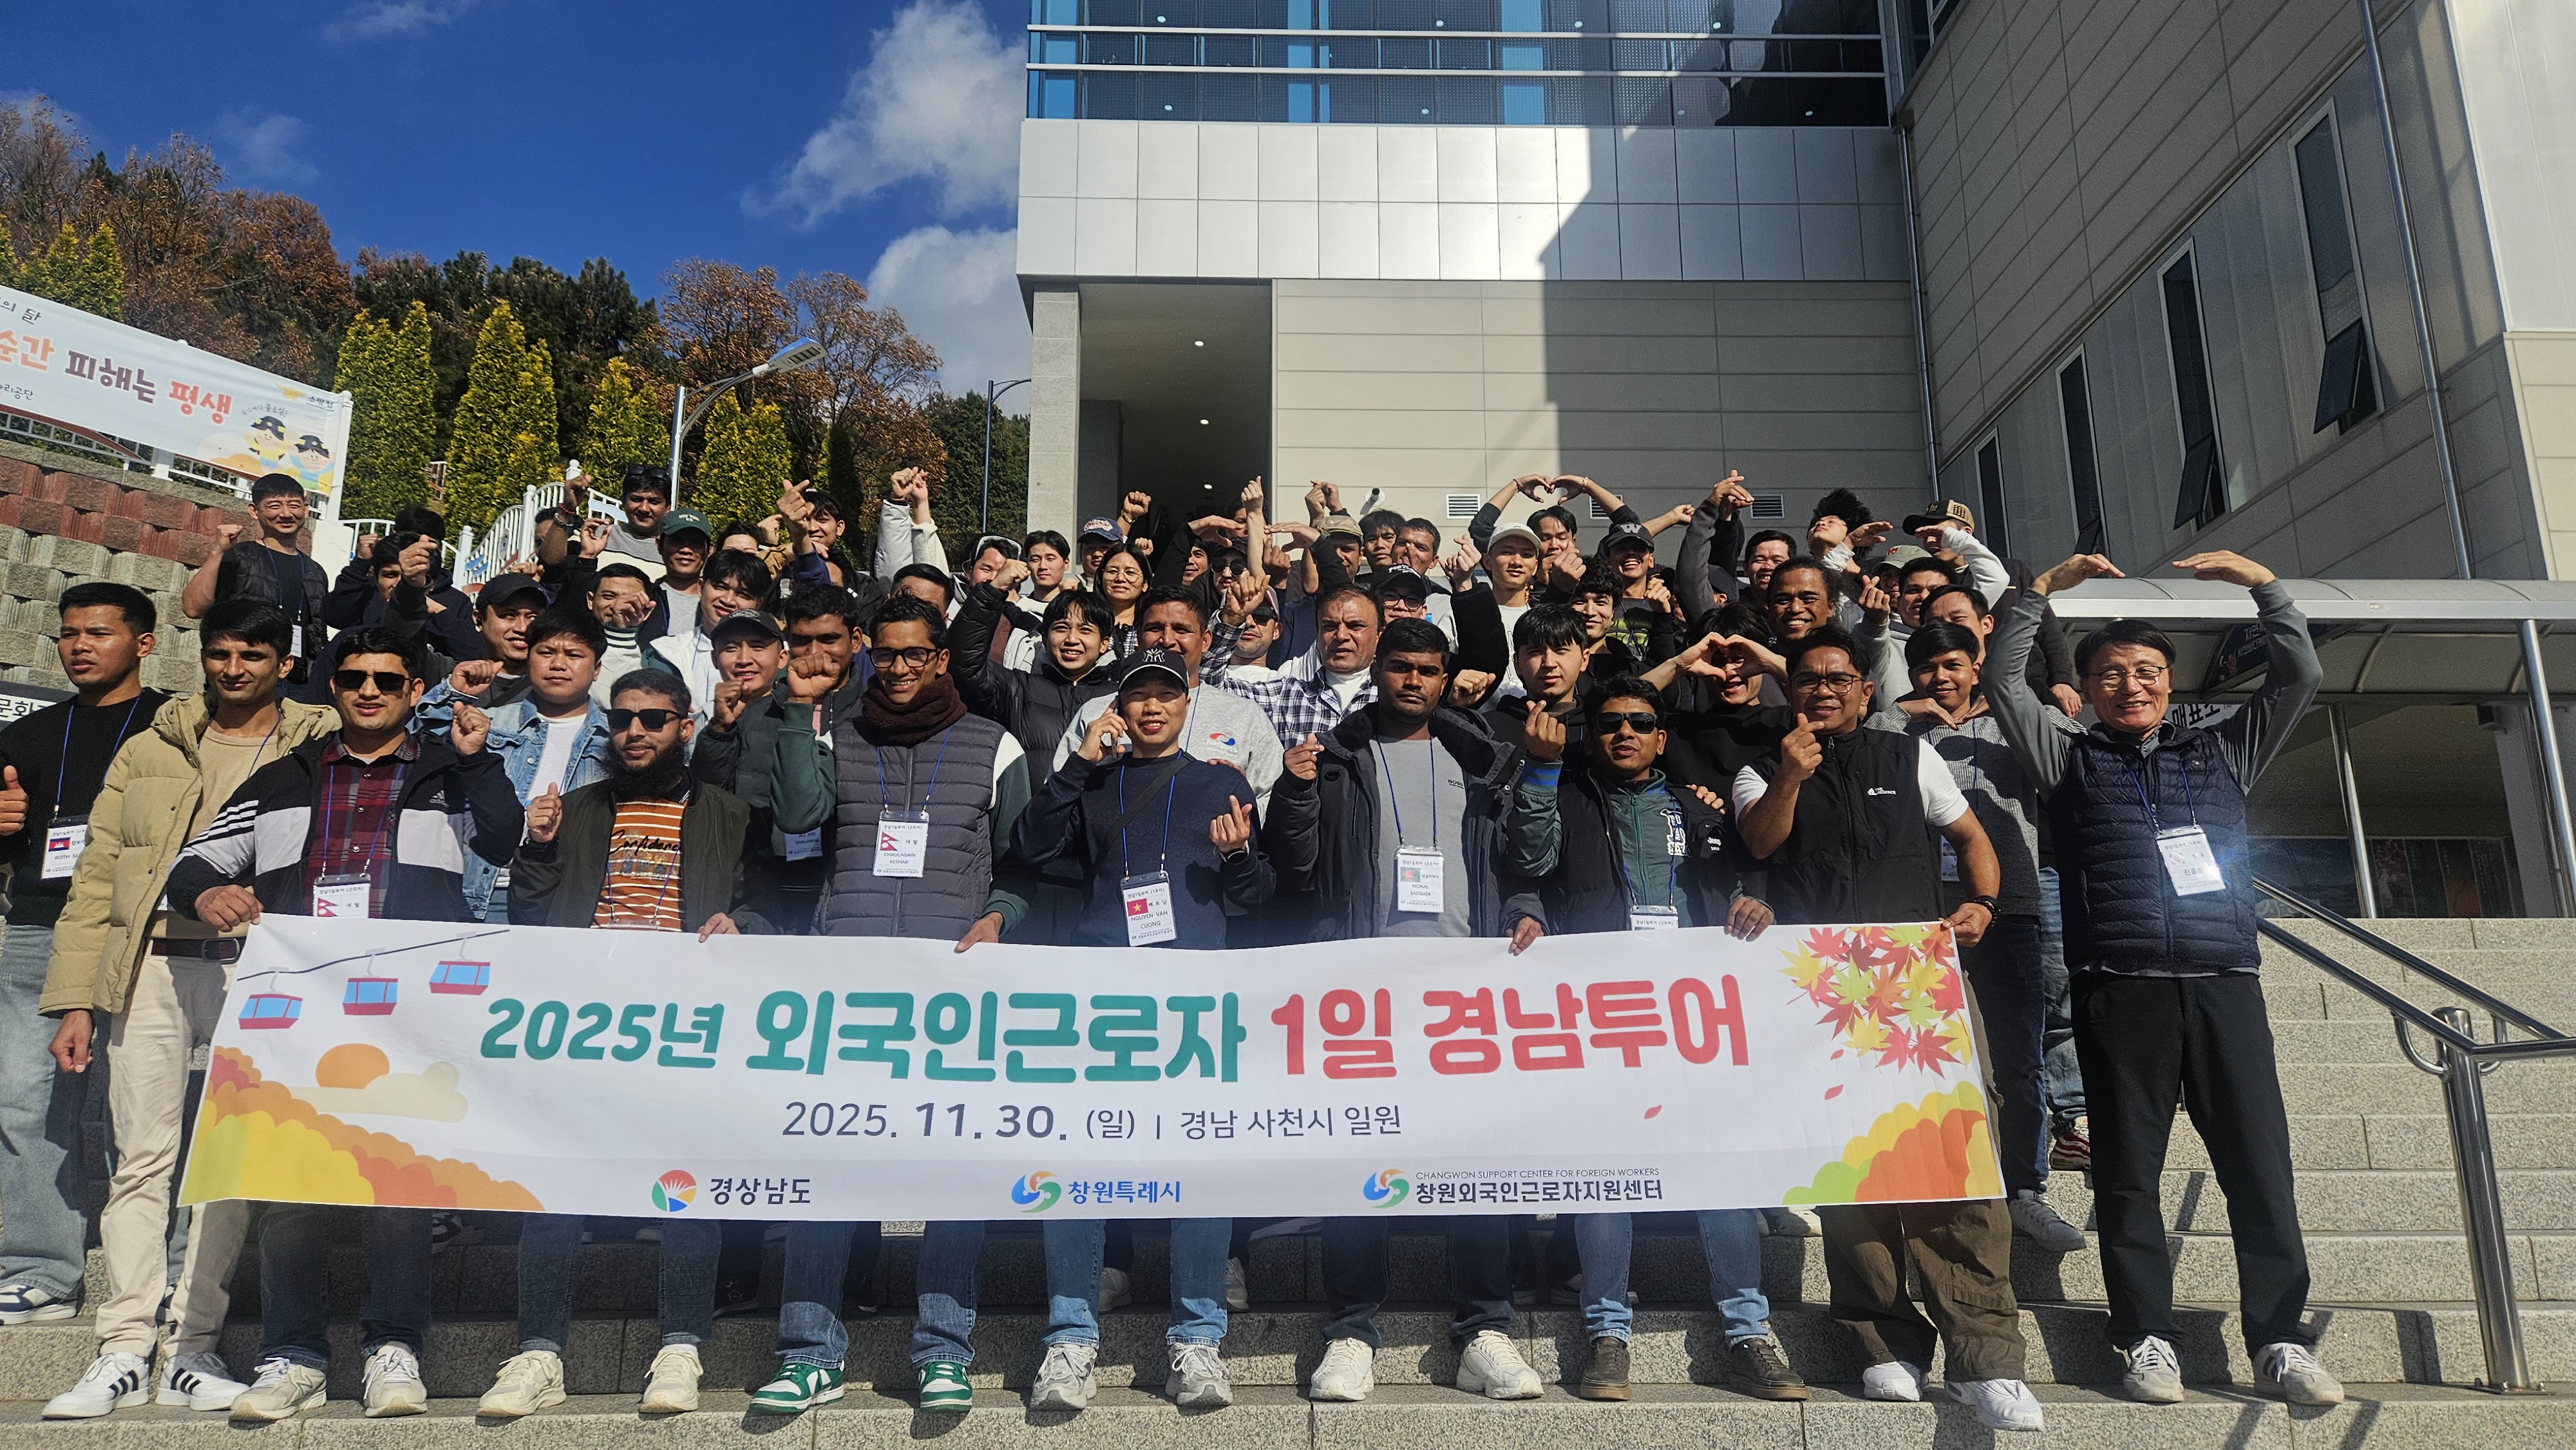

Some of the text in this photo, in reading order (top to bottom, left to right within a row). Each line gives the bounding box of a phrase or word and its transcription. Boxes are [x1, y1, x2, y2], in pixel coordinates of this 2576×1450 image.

[0, 297, 41, 325] 의 달
[0, 384, 33, 400] 리공단
[65, 350, 156, 403] 피해는
[169, 381, 232, 424] 평생
[1620, 523, 1642, 533] W
[0, 699, 47, 717] 문화
[2172, 703, 2220, 728] 매표소
[1131, 913, 1153, 921] NGUYEN
[480, 974, 1749, 1082] 2025년 외국인근로자 1일 경남투어
[782, 1102, 896, 1138] 2025.
[916, 1102, 981, 1139] 11.
[995, 1105, 1066, 1141] 30.
[1086, 1109, 1135, 1140] (일)
[1180, 1110, 1237, 1140] 경남
[1247, 1107, 1333, 1138] 사천시
[1344, 1105, 1401, 1136] 일원
[1416, 1171, 1475, 1180] CHANGWON
[1478, 1171, 1517, 1179] SUPPORT
[1520, 1170, 1553, 1178] CENTER
[1618, 1168, 1660, 1176] WORKERS
[710, 1178, 811, 1205] 경상남도
[1068, 1181, 1180, 1204] 창원특례시
[1416, 1179, 1663, 1204] 창원외국인근로자지원센터
